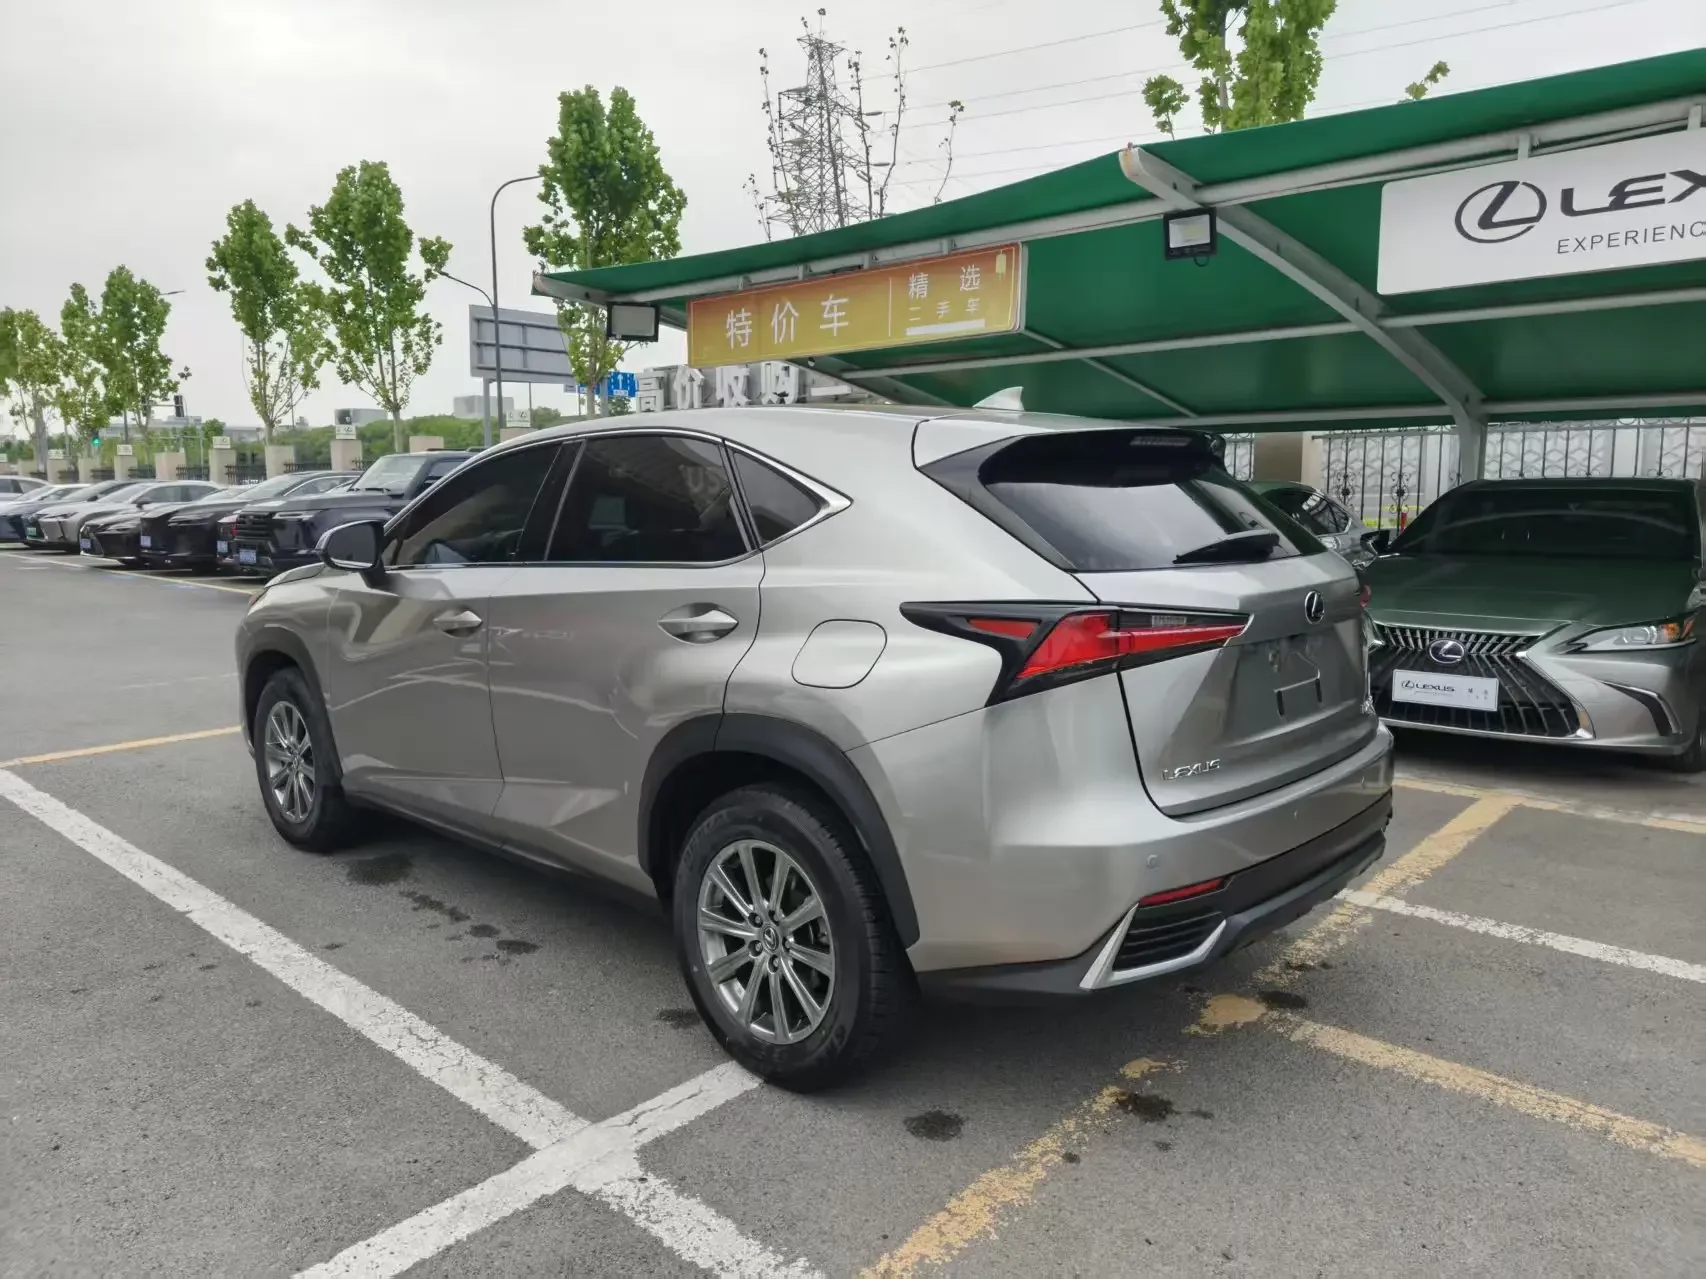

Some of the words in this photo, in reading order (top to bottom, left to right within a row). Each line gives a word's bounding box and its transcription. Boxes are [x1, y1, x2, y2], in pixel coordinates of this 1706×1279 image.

[908, 263, 981, 299] 精选
[725, 293, 849, 349] 特价车
[908, 298, 980, 321] 二手车
[1415, 683, 1456, 692] LEXUS
[1162, 758, 1221, 781] LEXUS
